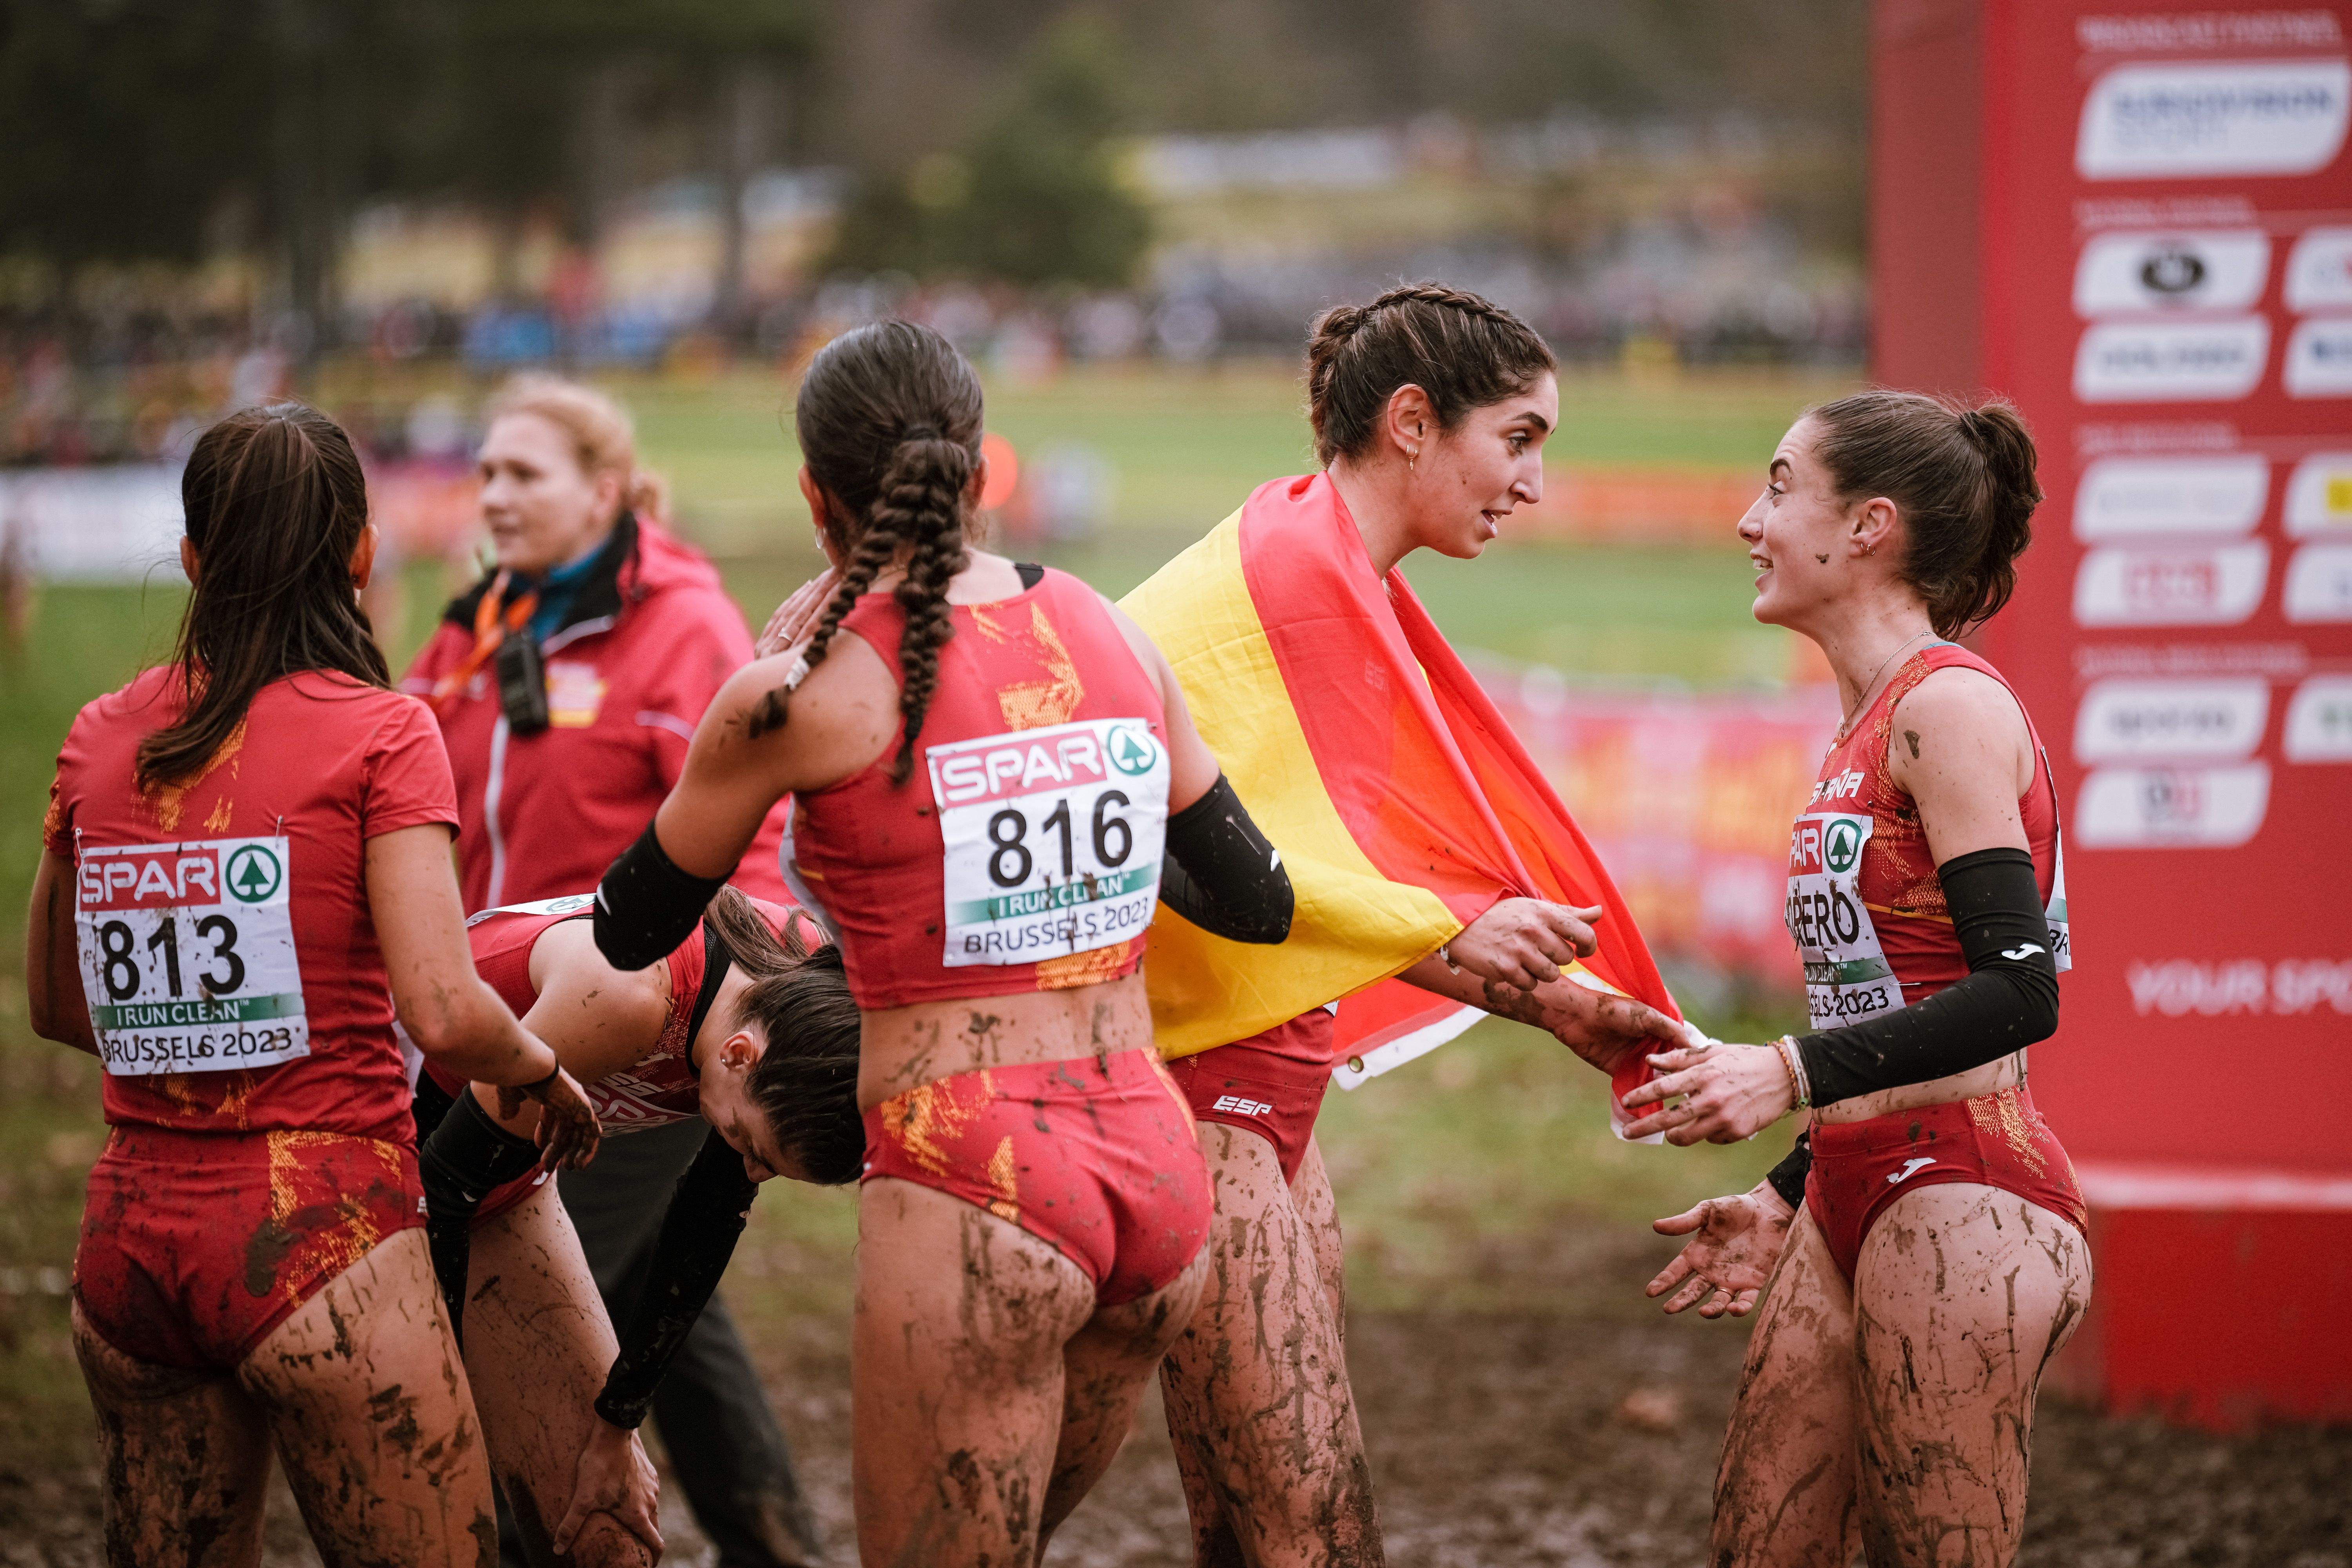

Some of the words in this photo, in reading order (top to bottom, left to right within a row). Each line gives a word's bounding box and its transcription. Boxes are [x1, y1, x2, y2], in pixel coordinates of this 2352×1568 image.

[941, 736, 1102, 802] SPAR
[987, 789, 1132, 887] 816
[80, 856, 216, 903] SPAR
[998, 897, 1004, 916] I
[1009, 890, 1055, 916] RUN
[964, 912, 1099, 953] BRUSSELS
[1105, 897, 1148, 929] 2023
[100, 914, 245, 1001] 813
[1833, 987, 1889, 1017] 2023
[2130, 962, 2265, 1013] YOUR
[117, 1008, 122, 1026] I
[125, 1005, 167, 1026] RUN
[103, 1034, 215, 1062] BRUSSELS
[222, 1027, 292, 1056] 2023
[1212, 1095, 1273, 1116] ESP
